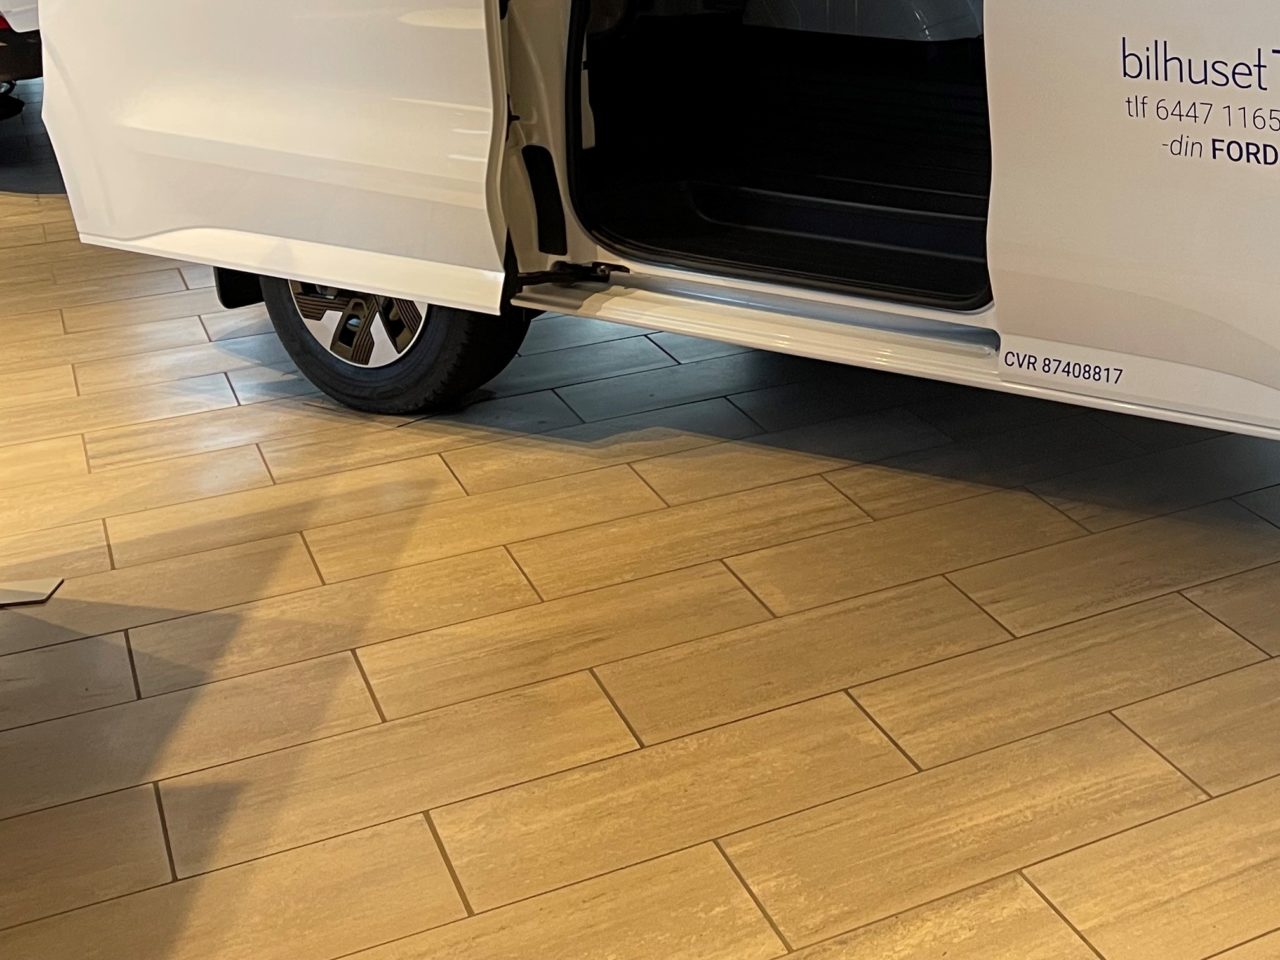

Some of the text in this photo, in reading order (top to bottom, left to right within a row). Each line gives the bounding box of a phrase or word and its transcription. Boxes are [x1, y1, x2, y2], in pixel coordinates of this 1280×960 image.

[1125, 95, 1149, 120] tlf
[1156, 98, 1213, 126] 6447
[1210, 138, 1279, 167] FORD
[1003, 351, 1124, 385] CVR 87408817
